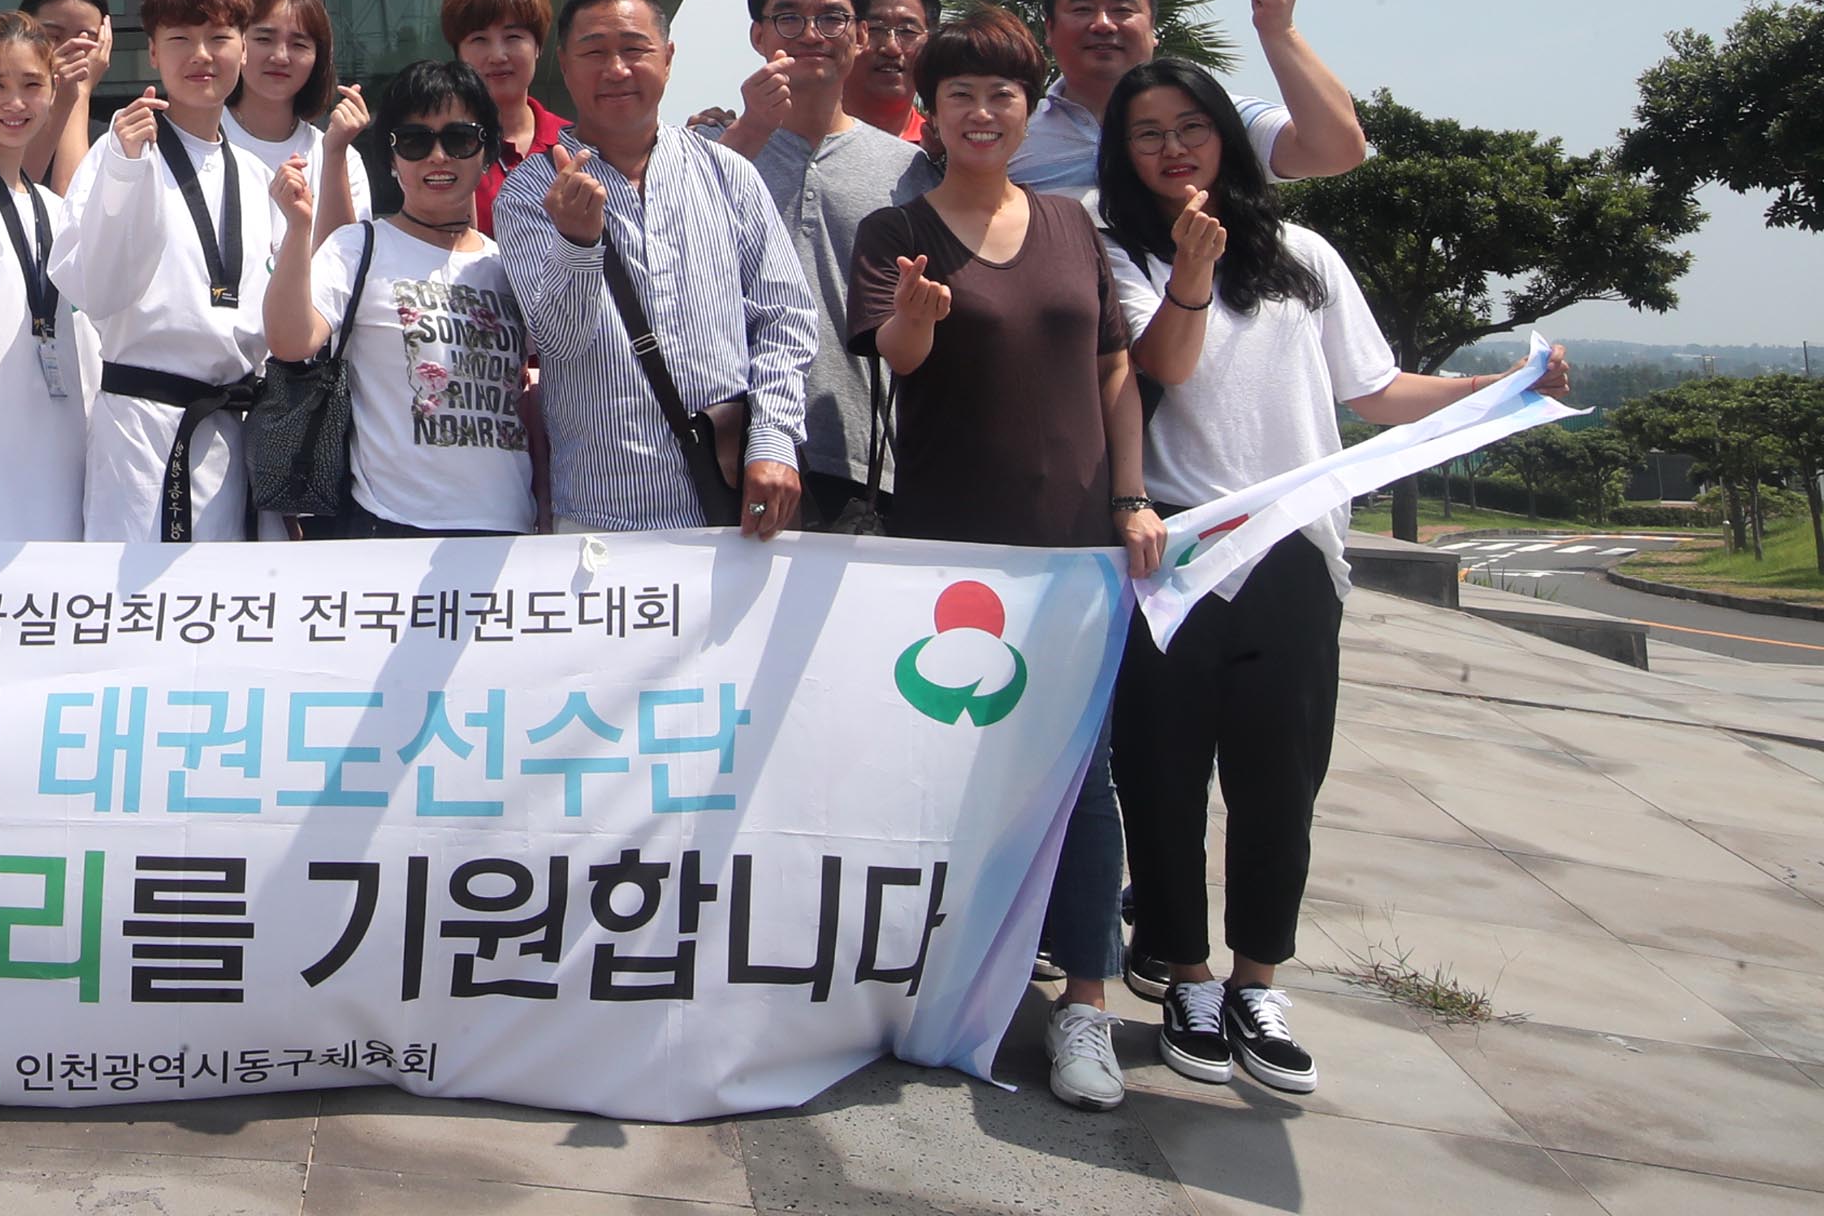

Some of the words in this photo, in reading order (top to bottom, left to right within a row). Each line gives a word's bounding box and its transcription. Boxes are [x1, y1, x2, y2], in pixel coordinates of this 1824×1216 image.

[299, 583, 680, 644] 전국태권도대회
[39, 682, 752, 816] 태권도선수단
[302, 849, 948, 1003] 기원합니다
[15, 1040, 438, 1091] 인천광역시동구체육회
